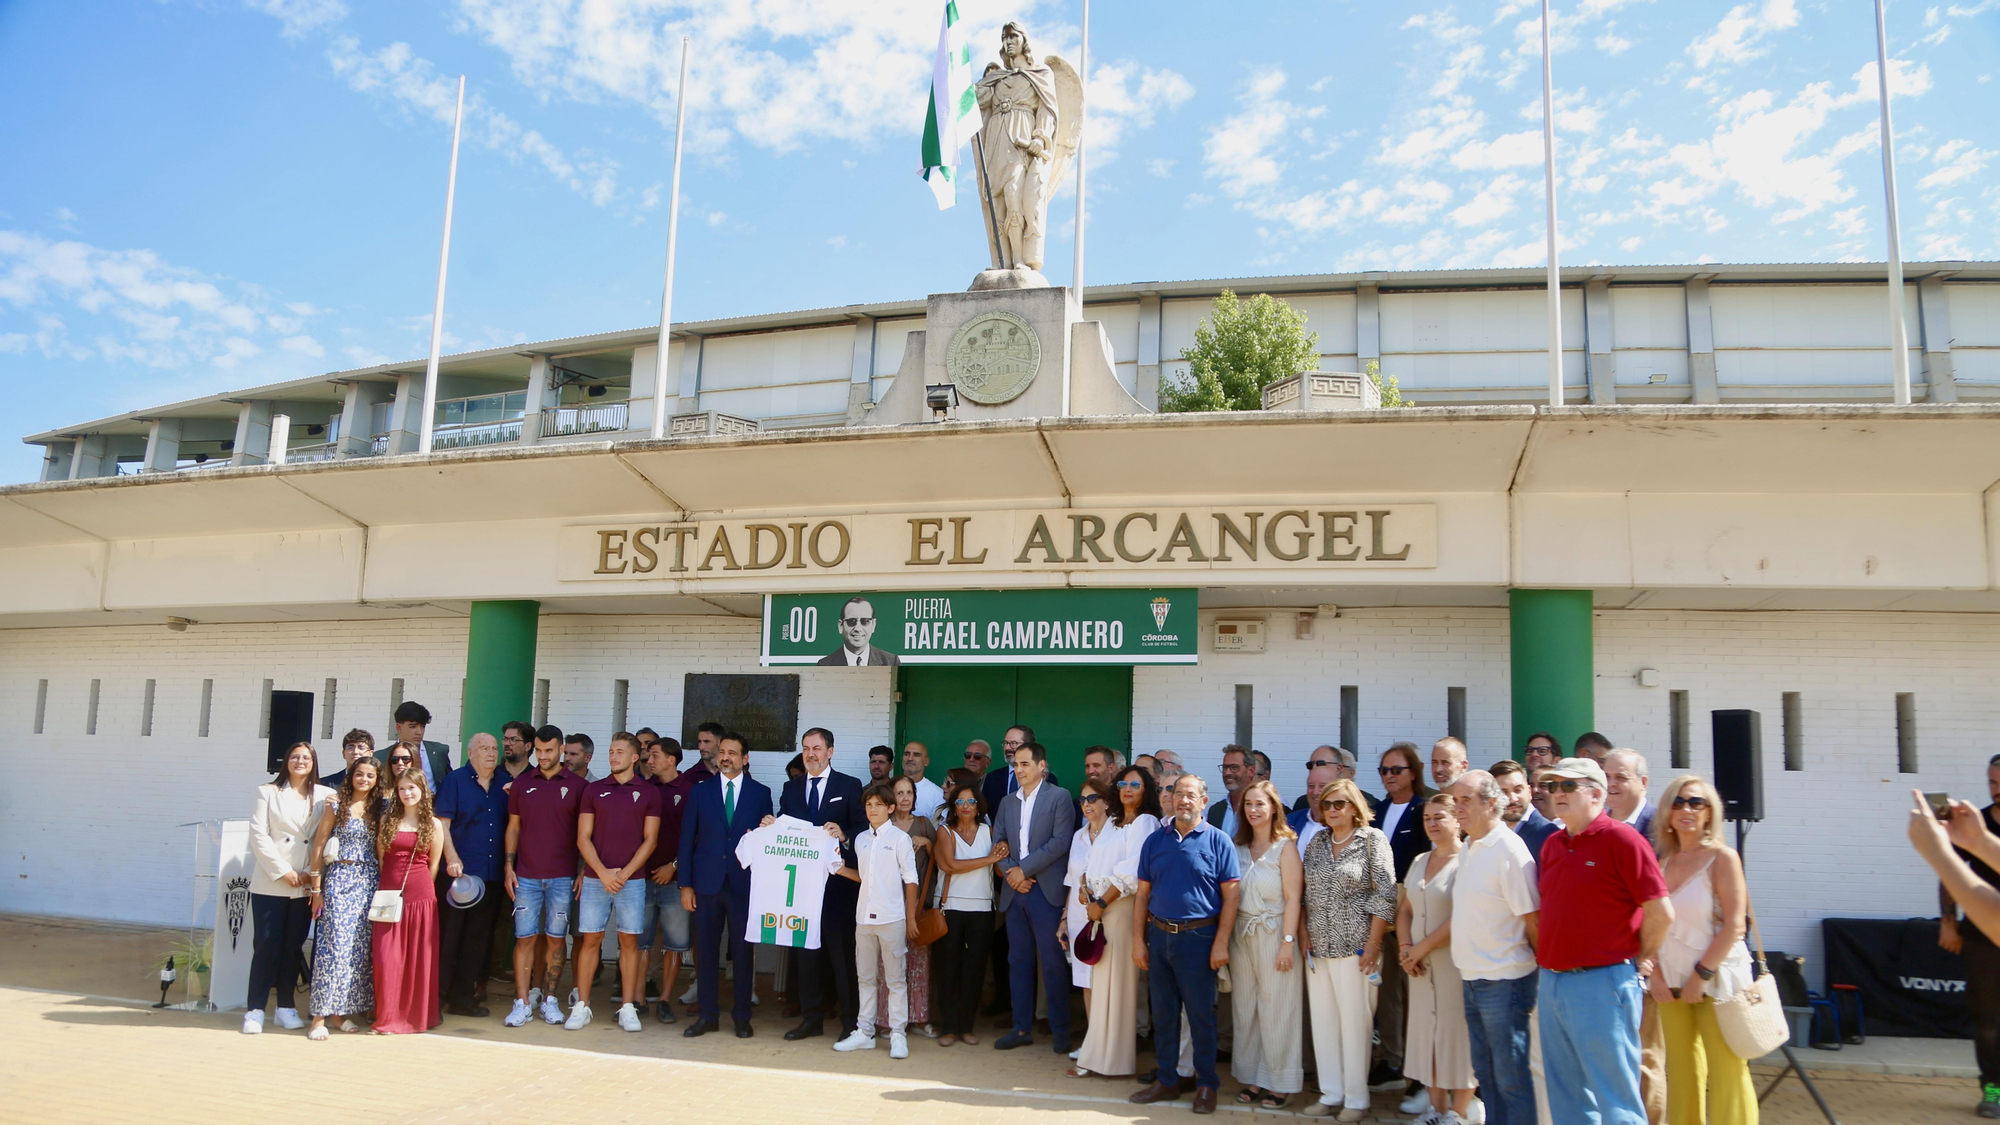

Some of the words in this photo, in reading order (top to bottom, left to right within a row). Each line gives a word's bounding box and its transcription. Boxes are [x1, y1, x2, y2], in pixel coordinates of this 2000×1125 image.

[593, 520, 851, 574] ESTADIO
[904, 516, 989, 566] EL
[1013, 509, 1411, 564] ARCANGEL
[904, 598, 952, 619] PUERTA
[789, 606, 818, 643] 00
[904, 621, 981, 649] RAFAEL
[986, 620, 1124, 649] CAMPANERO
[1141, 633, 1179, 641] CÓRDOBA
[1218, 635, 1243, 644] EBER
[776, 834, 809, 847] RAFAEL
[764, 845, 820, 860] CAMPANERO
[784, 864, 797, 907] 1
[764, 912, 806, 931] DIGI
[1899, 975, 1967, 992] VONYX
